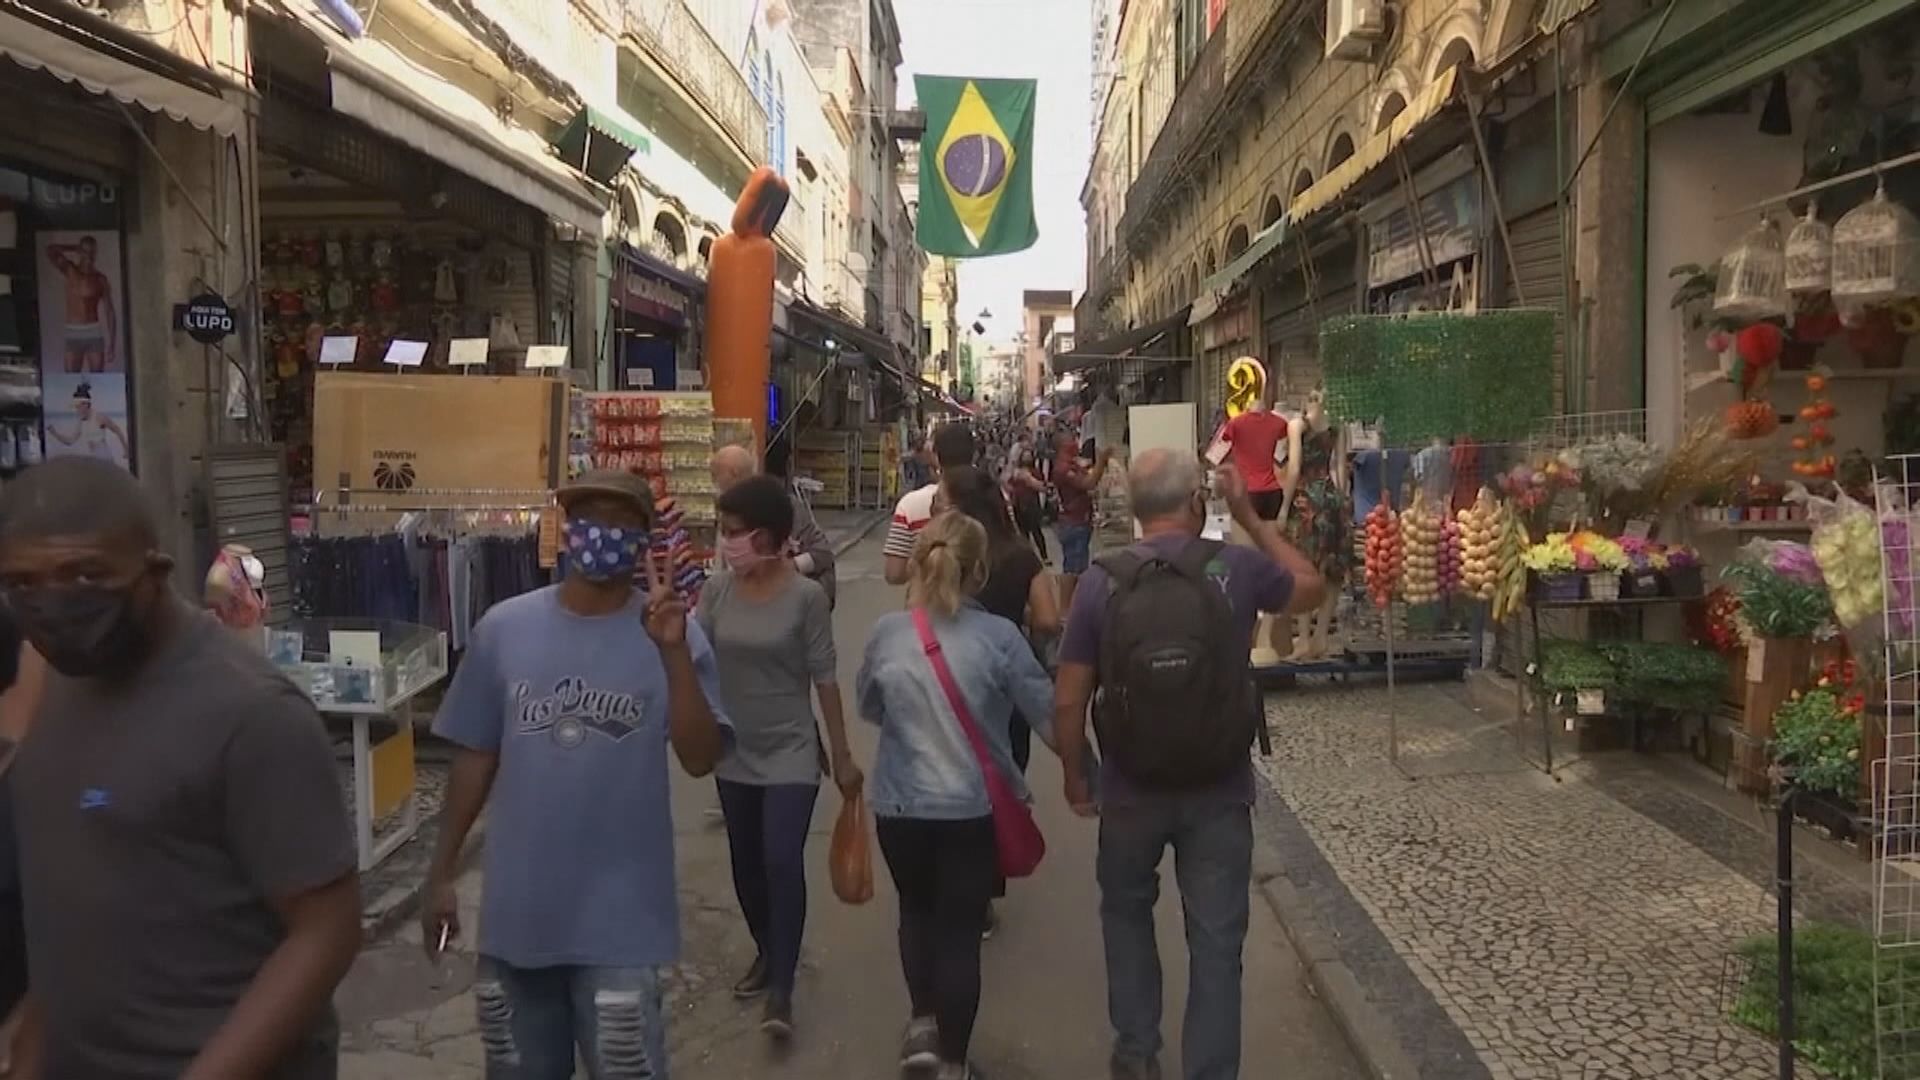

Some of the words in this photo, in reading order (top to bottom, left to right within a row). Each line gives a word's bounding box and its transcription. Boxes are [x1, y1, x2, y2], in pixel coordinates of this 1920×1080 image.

[43, 183, 115, 204] LUPO
[183, 312, 233, 330] LUPO
[373, 450, 417, 460] HUAWEI
[513, 680, 553, 723] Las
[554, 676, 642, 722] Vegas
